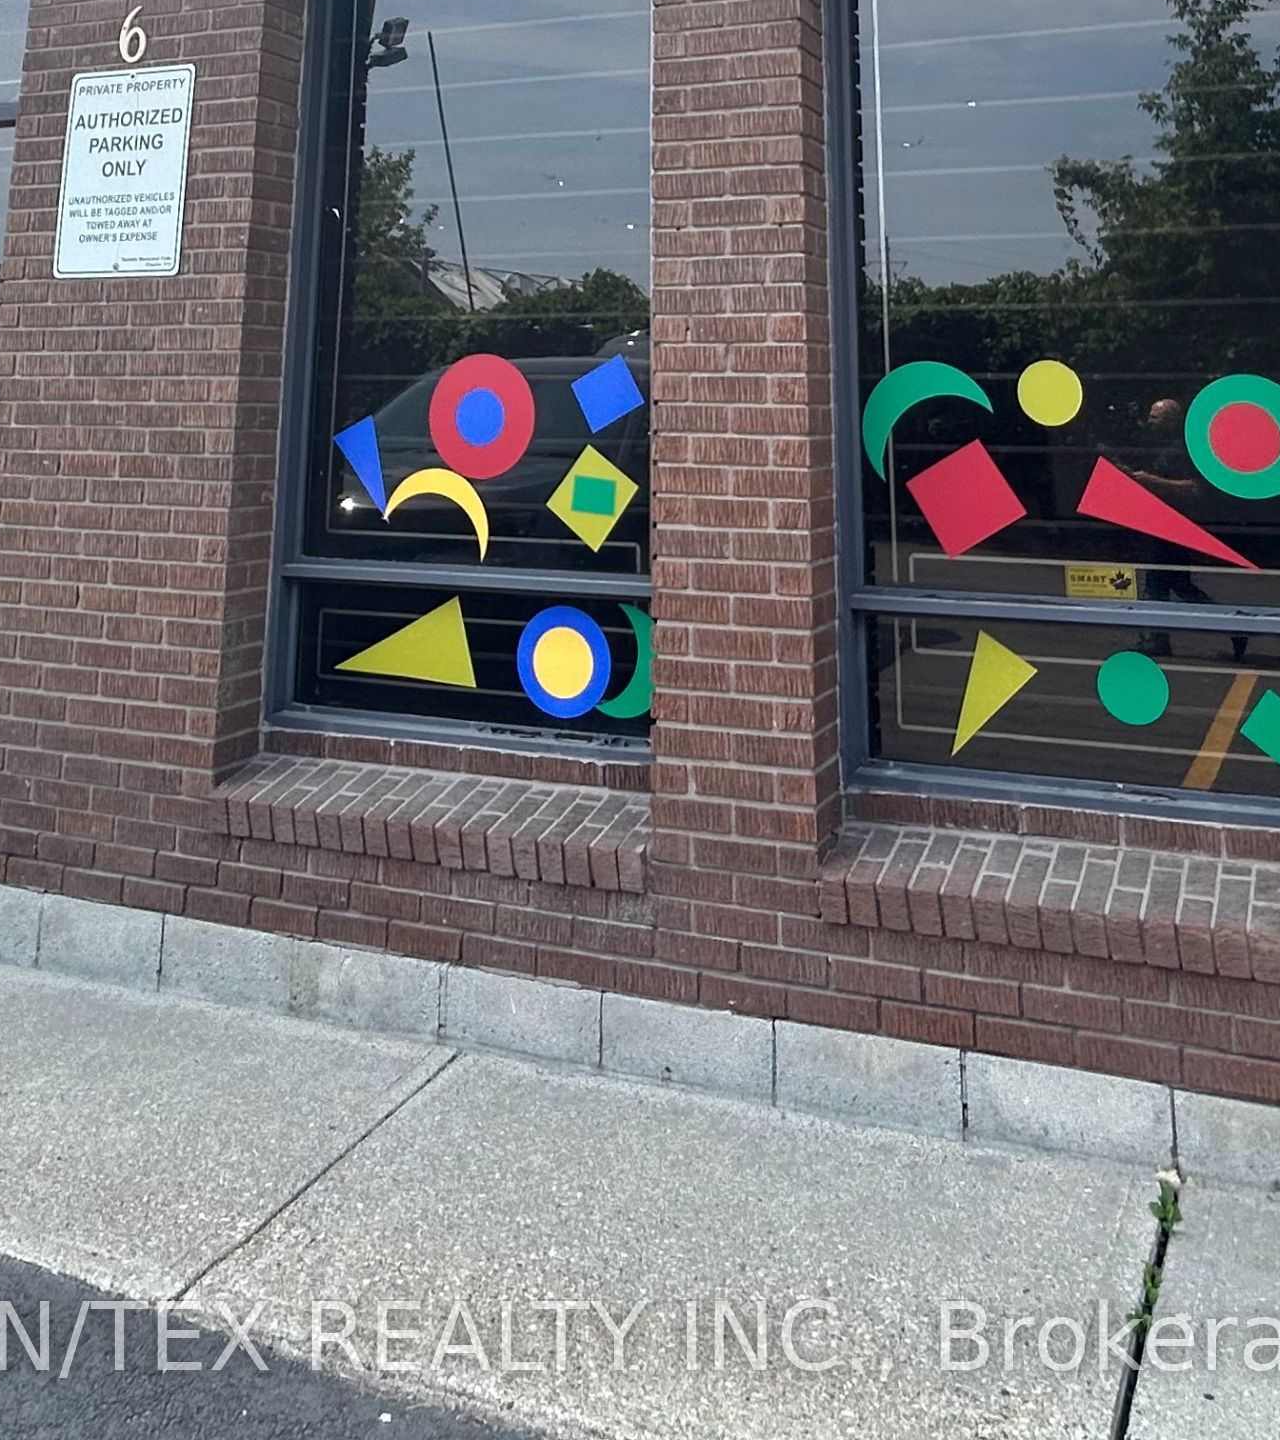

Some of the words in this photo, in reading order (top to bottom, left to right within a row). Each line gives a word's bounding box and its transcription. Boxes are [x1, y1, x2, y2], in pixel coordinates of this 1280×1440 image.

[119, 6, 147, 63] 6
[79, 83, 123, 96] PRIVATE
[126, 78, 186, 93] PROPERTY
[75, 107, 183, 130] AUTHORIZED
[88, 133, 164, 154] PARKING
[102, 160, 147, 177] ONLY
[68, 194, 132, 205] UNAUTHORIZED
[134, 191, 175, 202] VEHICLES
[69, 209, 89, 218] WILL
[91, 208, 102, 217] BE
[105, 206, 138, 216] TAGGED
[140, 205, 172, 215] AND/OR
[86, 221, 115, 230] TOWED
[117, 219, 141, 229] AWAY
[142, 218, 153, 228] AT
[79, 233, 117, 243] OWNER'S
[120, 231, 159, 242] EXPENSE
[1070, 575, 1106, 584] SMART
